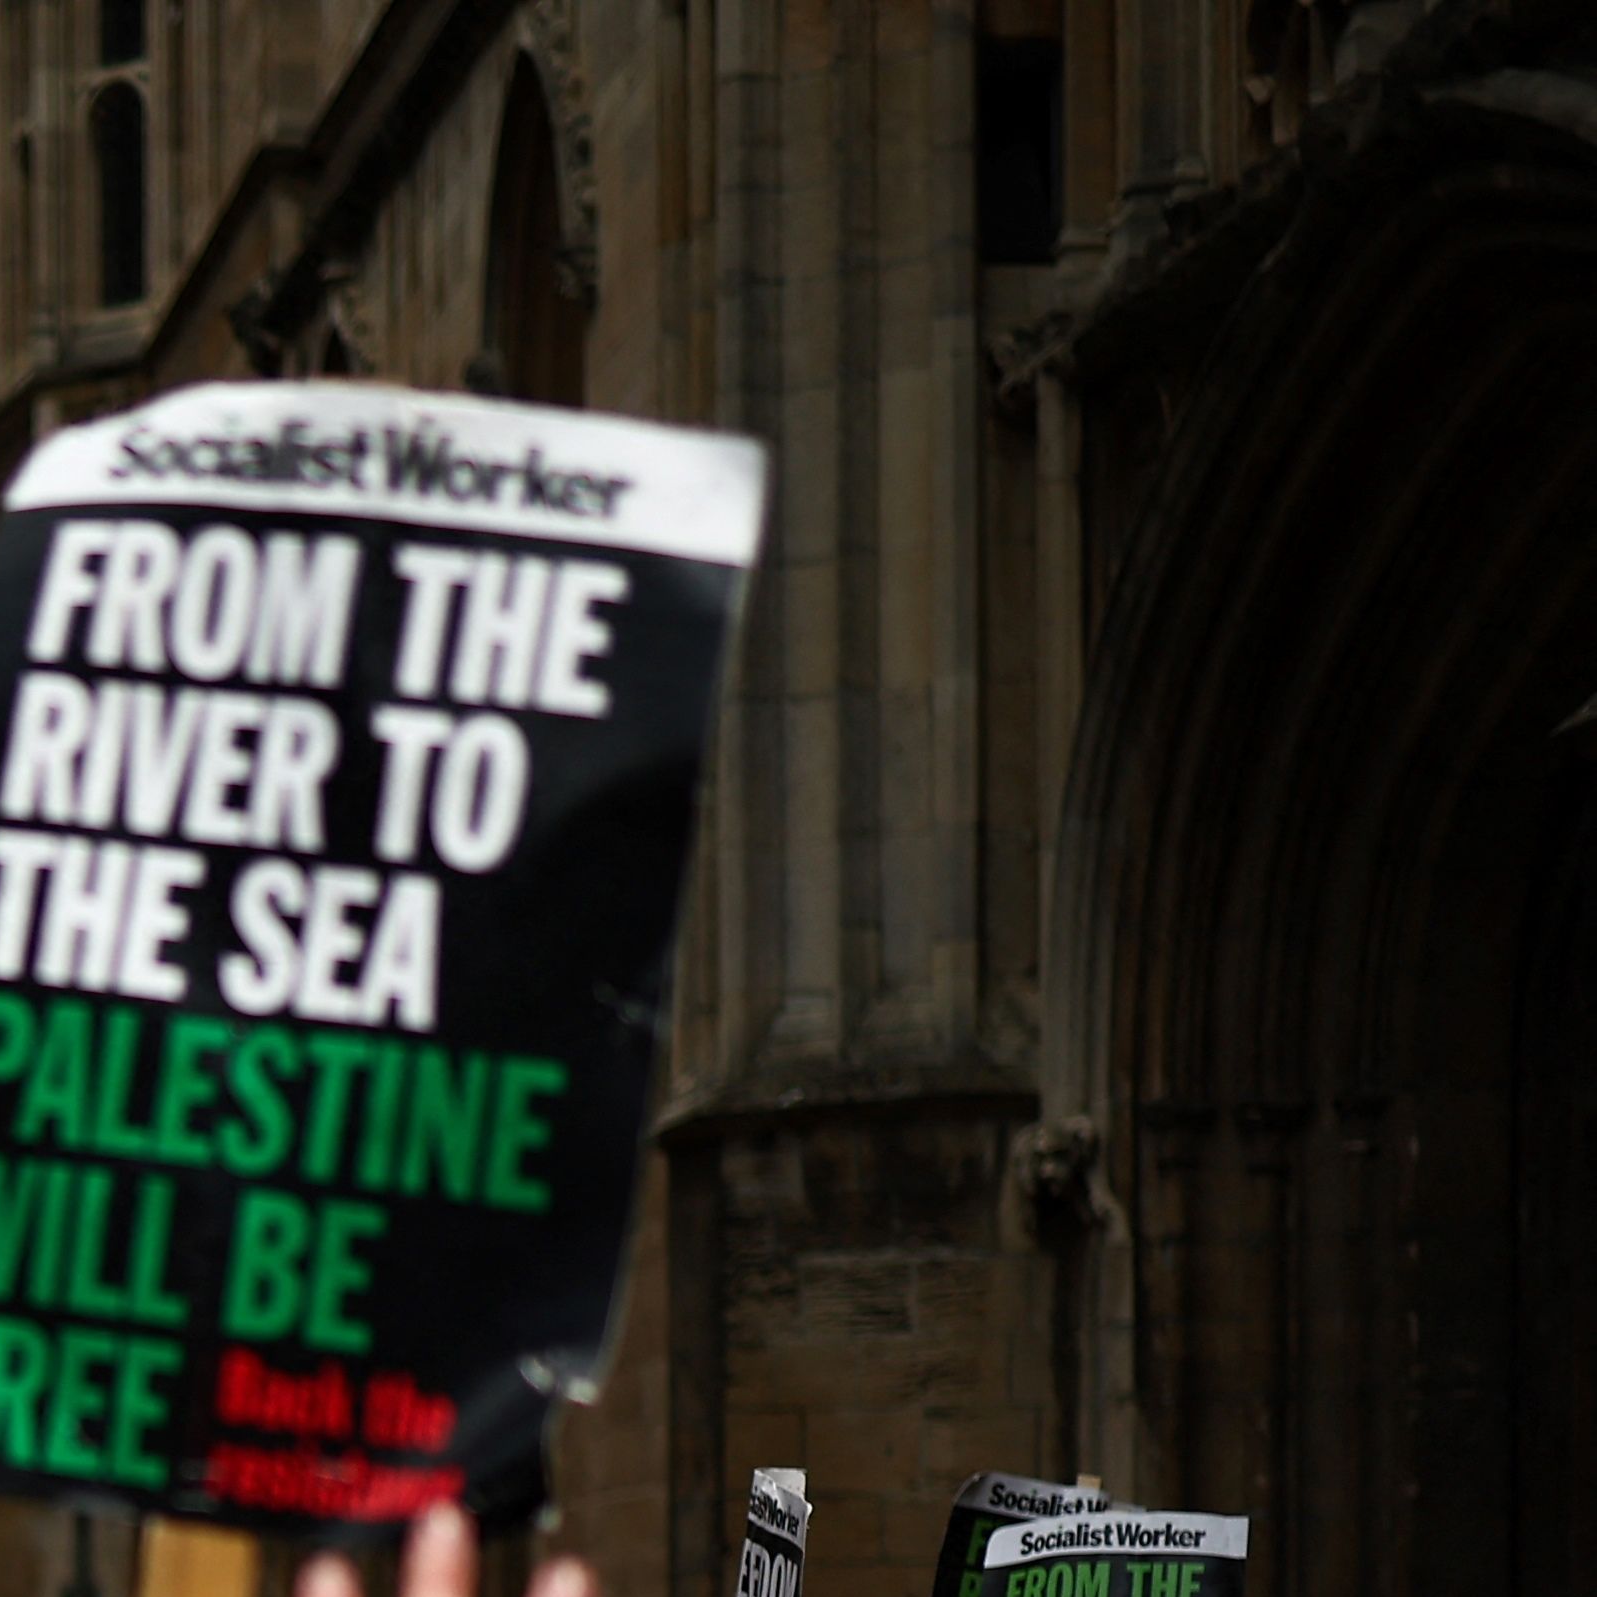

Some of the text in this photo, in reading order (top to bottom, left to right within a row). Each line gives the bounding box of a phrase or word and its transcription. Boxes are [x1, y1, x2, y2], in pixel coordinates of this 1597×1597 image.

[109, 418, 635, 519] Socialist Worker
[27, 520, 629, 718] FROM THE
[373, 709, 530, 873] TO
[218, 861, 441, 1031] SEA
[218, 1189, 385, 1355] BE
[1020, 1523, 1114, 1555] Socialist
[1116, 1522, 1206, 1549] Worker
